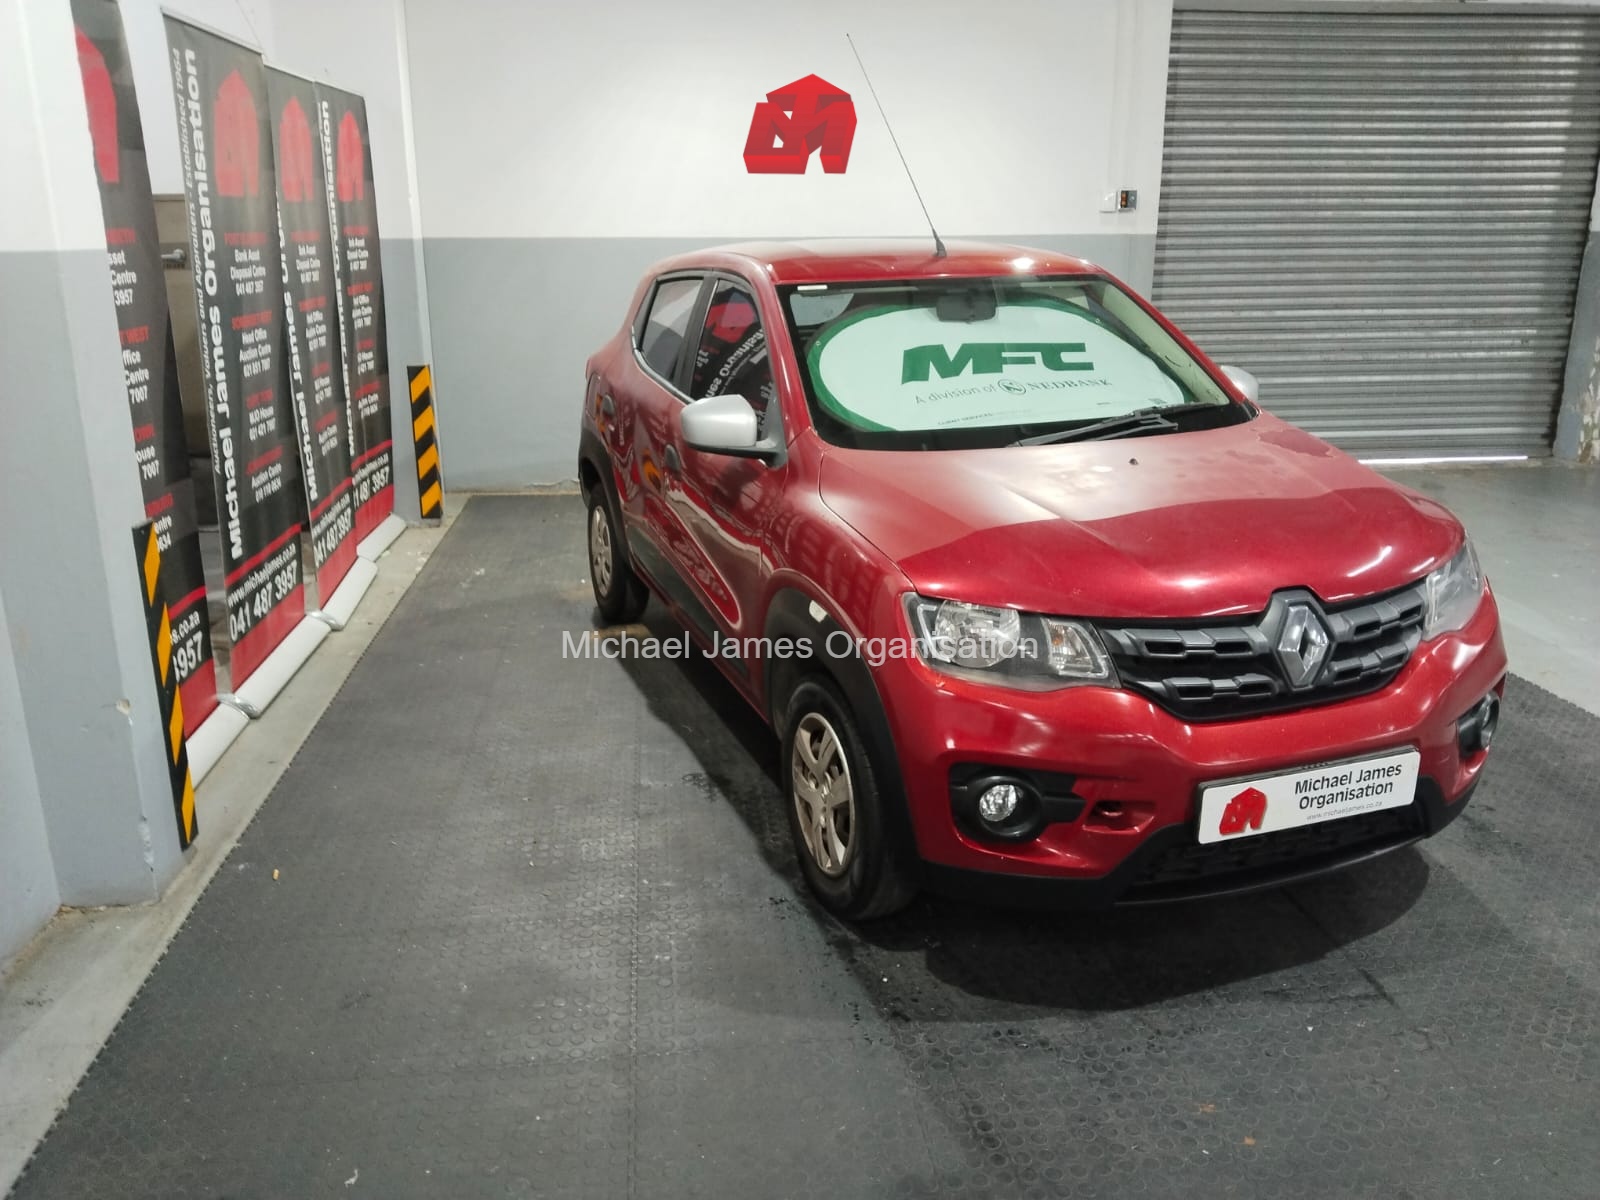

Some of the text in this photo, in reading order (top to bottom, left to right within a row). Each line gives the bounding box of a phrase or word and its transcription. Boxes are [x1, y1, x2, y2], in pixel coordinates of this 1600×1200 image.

[173, 48, 184, 89] 1964
[176, 93, 193, 188] Established
[190, 202, 204, 284] Appraisers
[114, 288, 133, 306] 3957
[185, 49, 243, 560] Michael James Organisation
[197, 287, 205, 319] and
[200, 323, 211, 378] Valuers
[901, 343, 1095, 385] MFC
[129, 385, 148, 405] 7007
[284, 291, 318, 502] Michael James
[914, 377, 1114, 405] A division of NEDBANK
[142, 459, 160, 480] 7007
[372, 465, 390, 493] 3957
[229, 559, 297, 642] 041 487 3957
[1295, 763, 1403, 795] Michael James
[1299, 780, 1394, 811] Organisation
